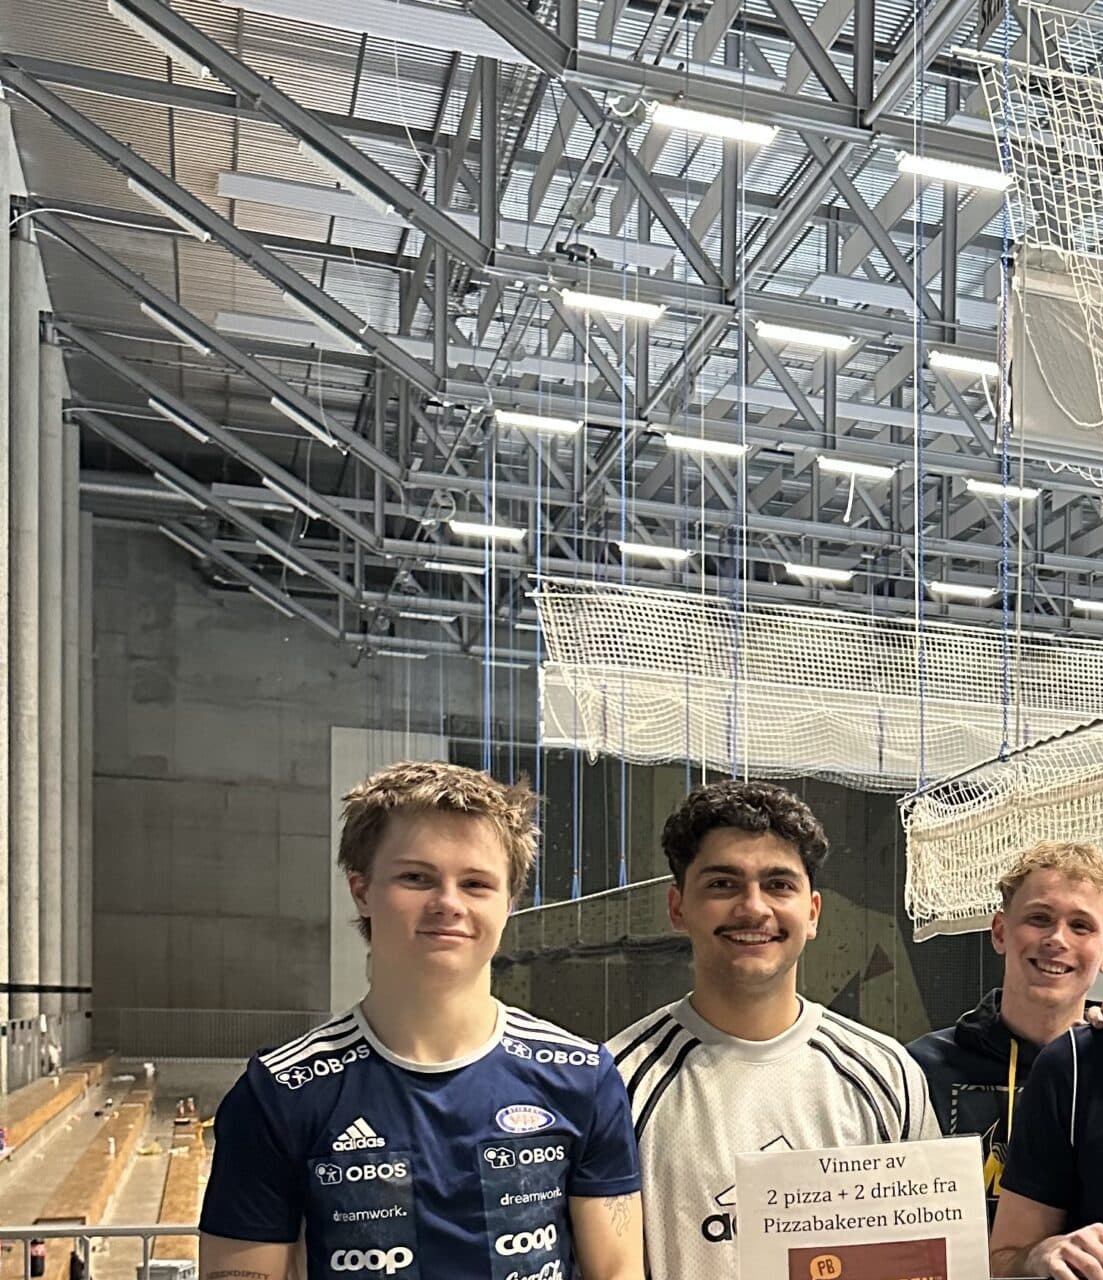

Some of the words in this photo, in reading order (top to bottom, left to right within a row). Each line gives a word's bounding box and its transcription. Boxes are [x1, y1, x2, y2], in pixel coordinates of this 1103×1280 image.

[535, 1048, 600, 1067] OBOS
[332, 1136, 386, 1152] adidas
[518, 1145, 565, 1165] OBOS
[819, 1156, 881, 1174] Vinner
[885, 1156, 907, 1170] av
[345, 1162, 407, 1182] OBOS
[767, 1190, 777, 1205] 2
[784, 1188, 832, 1209] pizza
[837, 1188, 849, 1200] +
[854, 1184, 865, 1200] 2
[871, 1179, 929, 1200] drikke
[933, 1178, 957, 1194] fra
[763, 1210, 888, 1234] Pizzabakeren
[893, 1204, 963, 1227] Kolbotn
[495, 1223, 557, 1256] coop
[330, 1246, 413, 1275] coop
[817, 1258, 835, 1277] PB
